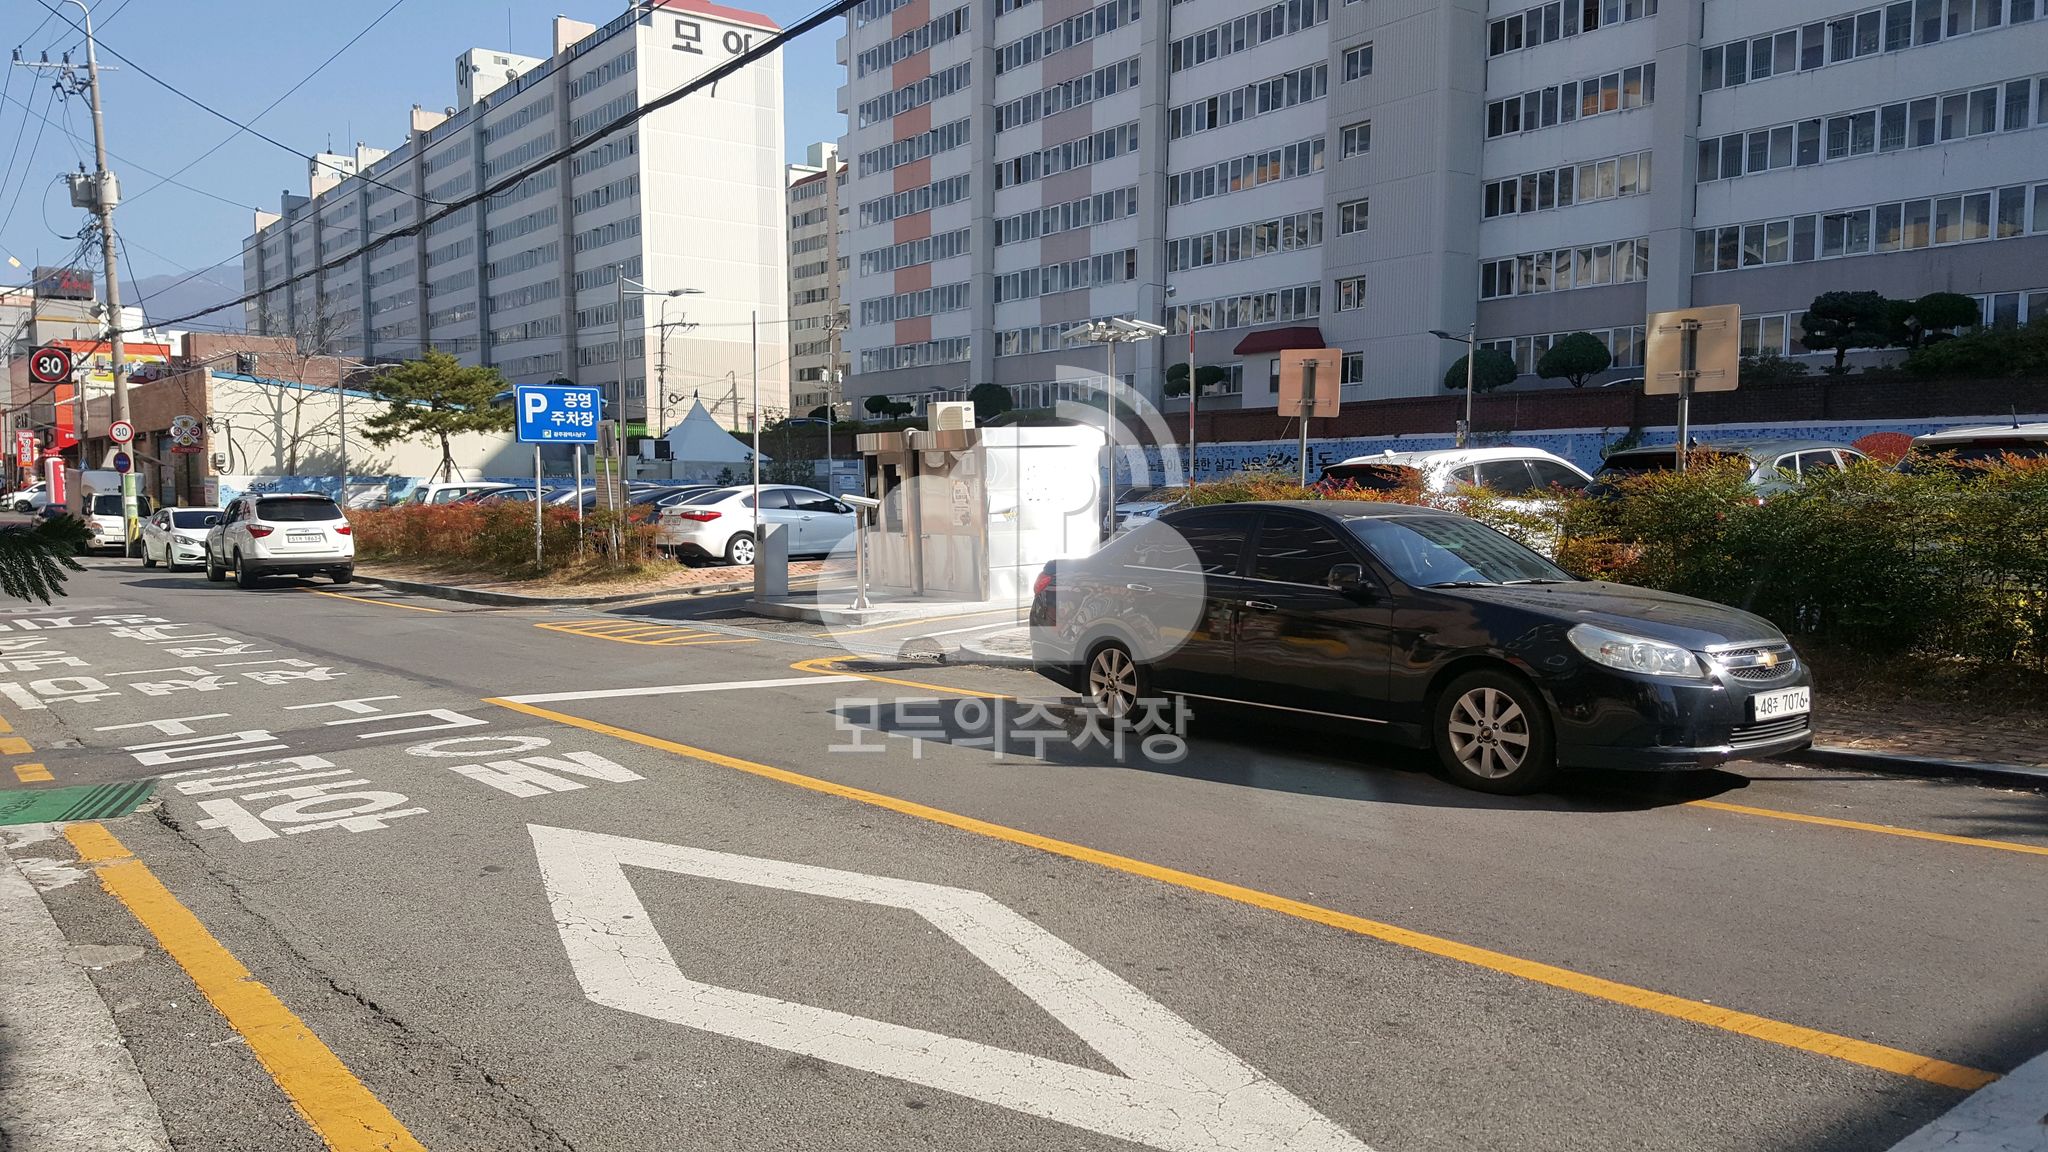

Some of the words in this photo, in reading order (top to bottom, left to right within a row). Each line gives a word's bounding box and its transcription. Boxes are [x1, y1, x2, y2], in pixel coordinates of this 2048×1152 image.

[39, 356, 62, 374] 30
[524, 392, 548, 423] P
[563, 392, 592, 409] 공영
[550, 411, 594, 427] 주차장
[115, 427, 128, 437] 30
[1215, 457, 1237, 472] 살고
[0, 614, 171, 631] 방지
[1759, 697, 1779, 715] 48주
[1783, 691, 1805, 711] 7076
[94, 695, 489, 767] 도로
[158, 735, 646, 843] 생활
